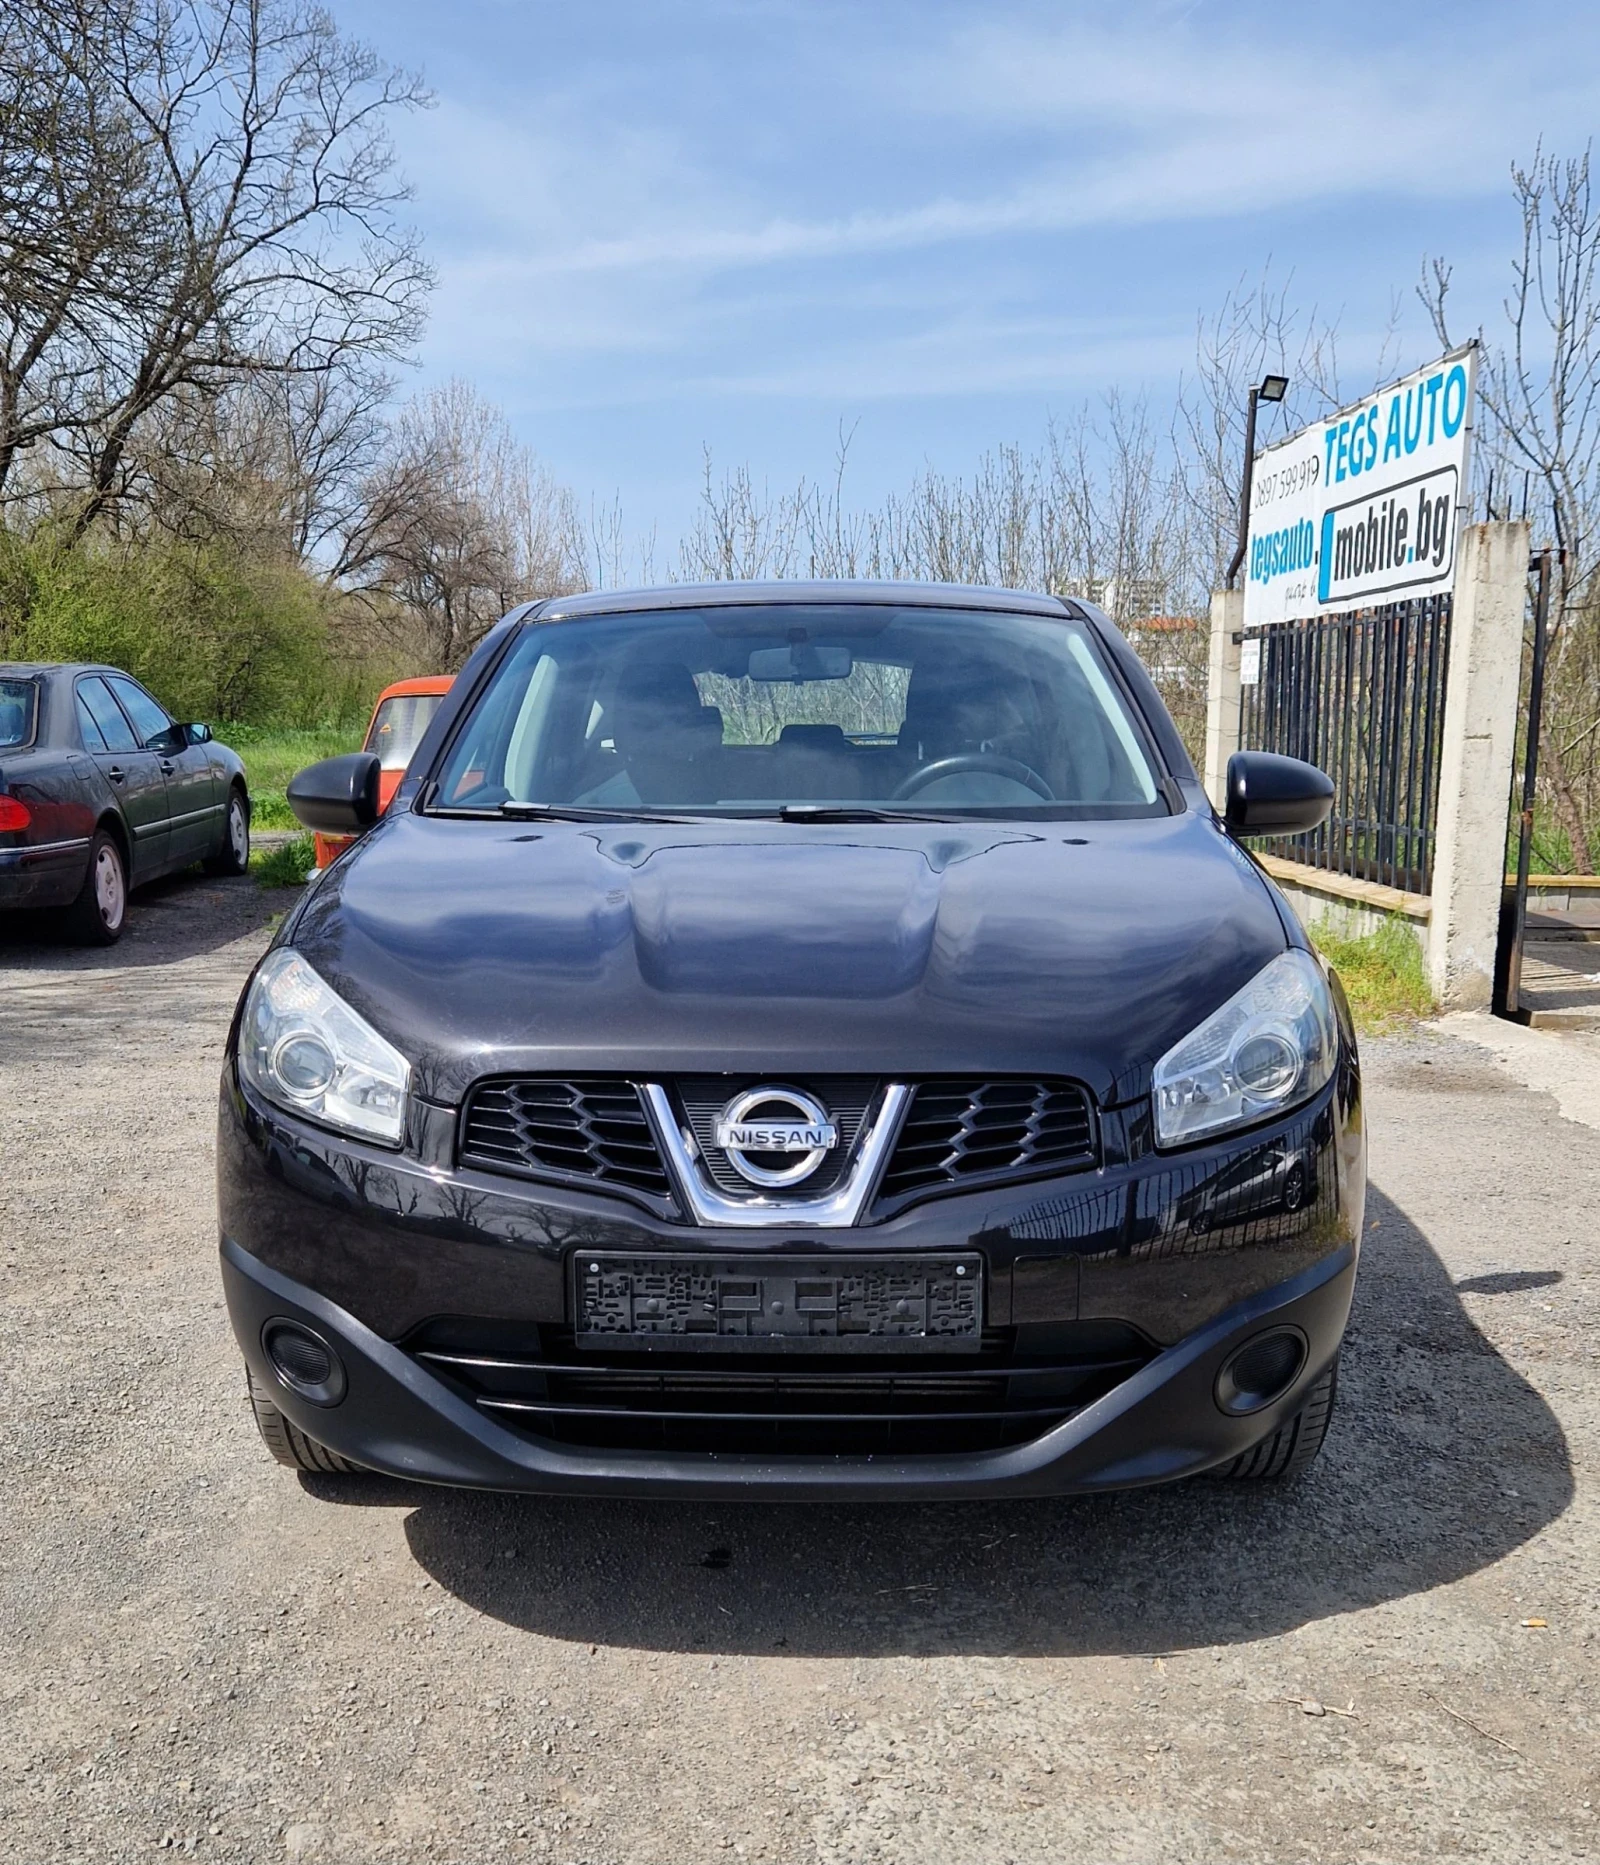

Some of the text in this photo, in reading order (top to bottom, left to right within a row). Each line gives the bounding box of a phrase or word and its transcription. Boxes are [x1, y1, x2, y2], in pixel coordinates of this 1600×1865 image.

[1324, 364, 1467, 487] TEGS AUTO
[1279, 464, 1299, 499] 599
[1299, 454, 1320, 491] 919
[1333, 487, 1450, 581] mobile.bg
[729, 1130, 822, 1144] NISSAN
